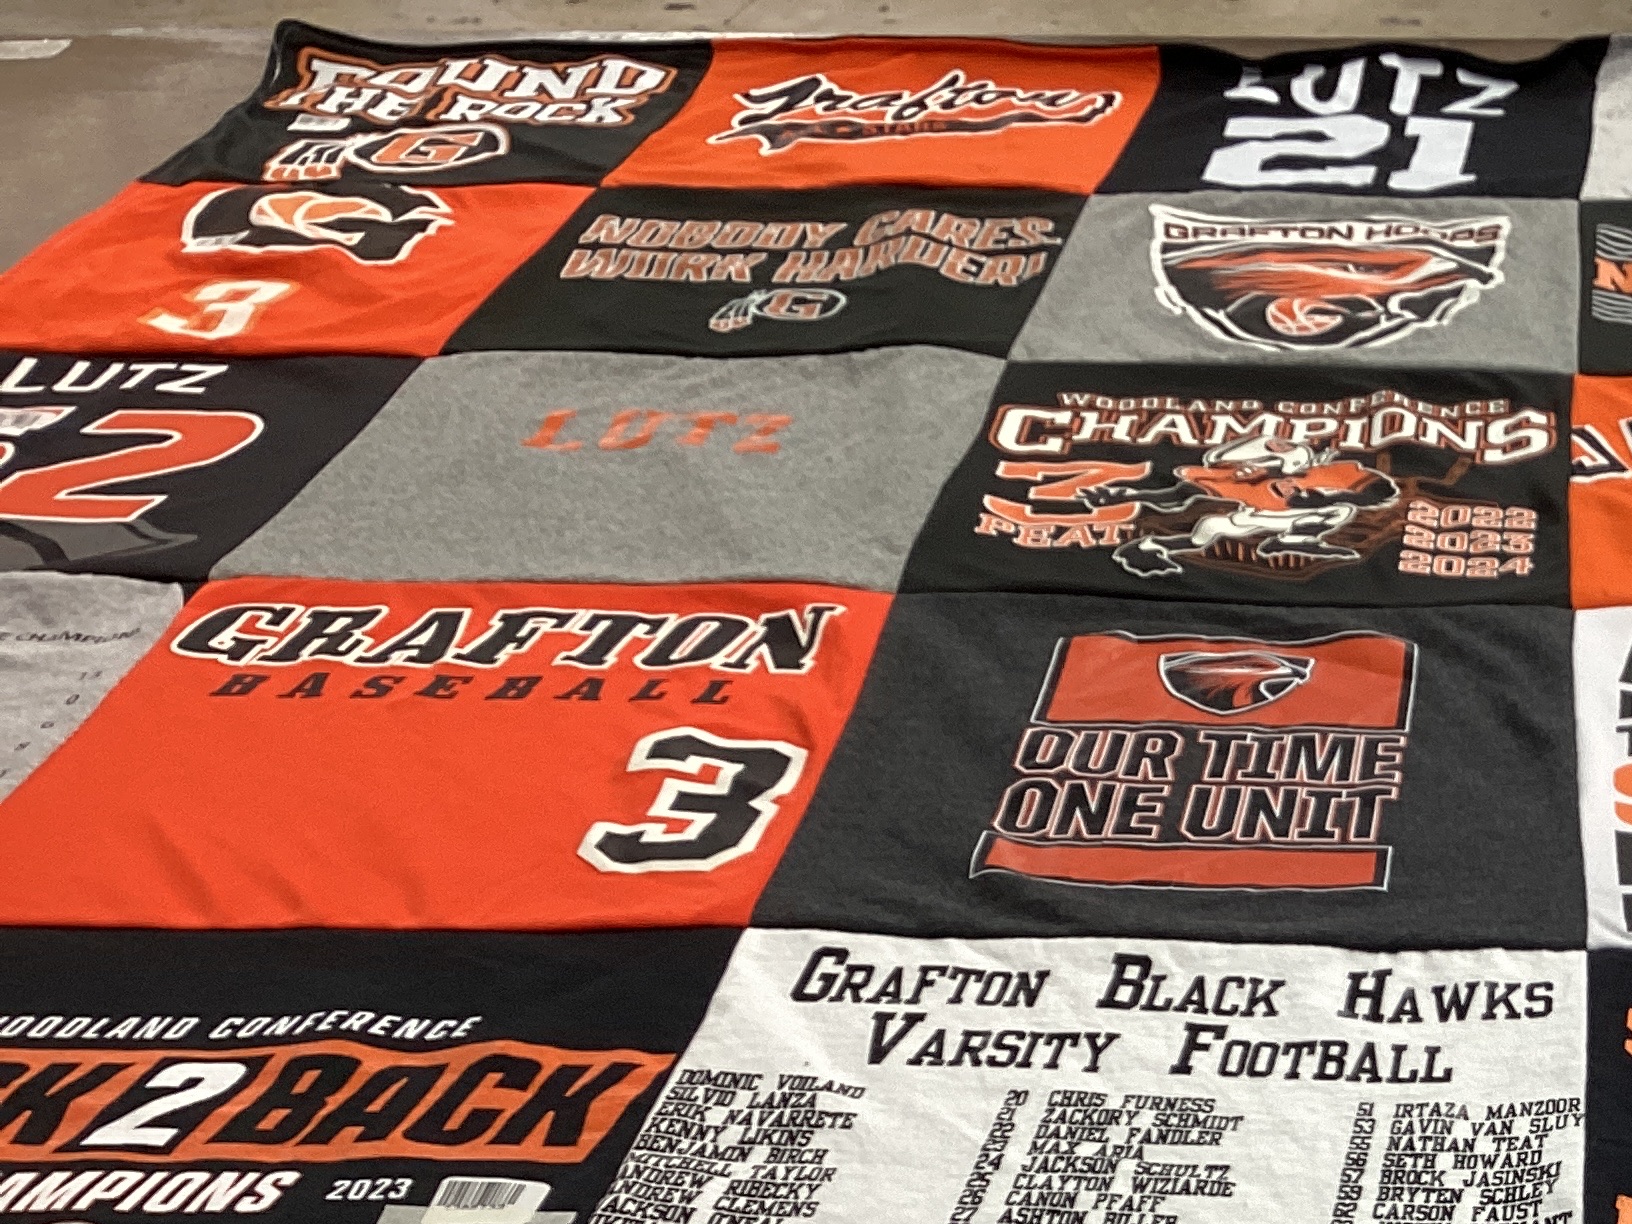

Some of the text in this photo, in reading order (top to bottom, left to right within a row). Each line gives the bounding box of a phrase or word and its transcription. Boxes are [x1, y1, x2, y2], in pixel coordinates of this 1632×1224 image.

[439, 95, 638, 125] ROCK
[1202, 113, 1477, 191] 21
[579, 208, 1062, 249] NOBODY CARES
[1163, 222, 1503, 244] GRAFTON HOOPS
[560, 235, 1048, 288] WORK HARDER!
[146, 280, 294, 340] 3
[0, 357, 228, 393] LUTZ
[1056, 391, 1511, 418] WOODLAND CONFERENCE
[520, 408, 793, 454] LUTZ
[994, 405, 1554, 465] CHAMPIONS
[983, 459, 1152, 526] 3
[974, 511, 1137, 549] PEAT
[1406, 499, 1539, 530] 2022
[1402, 524, 1537, 554] 2023
[1398, 548, 1535, 579] 2024
[169, 602, 848, 675] GRAFTON
[208, 673, 734, 705] BASEBALL
[1013, 727, 1408, 785] OUR TIME
[577, 726, 808, 874] 3
[994, 778, 1400, 843] ONE UNIT
[790, 945, 1554, 1025] GRAFTON BLACK HAWKS
[208, 1010, 484, 1041] CONFERENCE
[865, 1011, 1454, 1084] VARSITY FOOTBALL
[676, 1068, 866, 1099] DOMINIC VOILAND
[80, 1061, 249, 1147] 2
[205, 1053, 644, 1147] BACK
[1004, 1089, 1217, 1113] 20 CHRIS FURNESS
[1356, 1097, 1582, 1121] 51 IRTAZA MANZOOR
[656, 1102, 857, 1130] ERIK NAVARRETE
[1033, 1124, 1223, 1146] DANIEL FANDLER
[1386, 1133, 1549, 1153] NATHAN TEAT
[973, 1153, 1232, 1180] 24 JACKSON SCHULTZ
[1379, 1160, 1562, 1188] BROCK JASINSKI
[325, 1177, 411, 1202] 2023
[1004, 1190, 1166, 1213] CANON PFAFF
